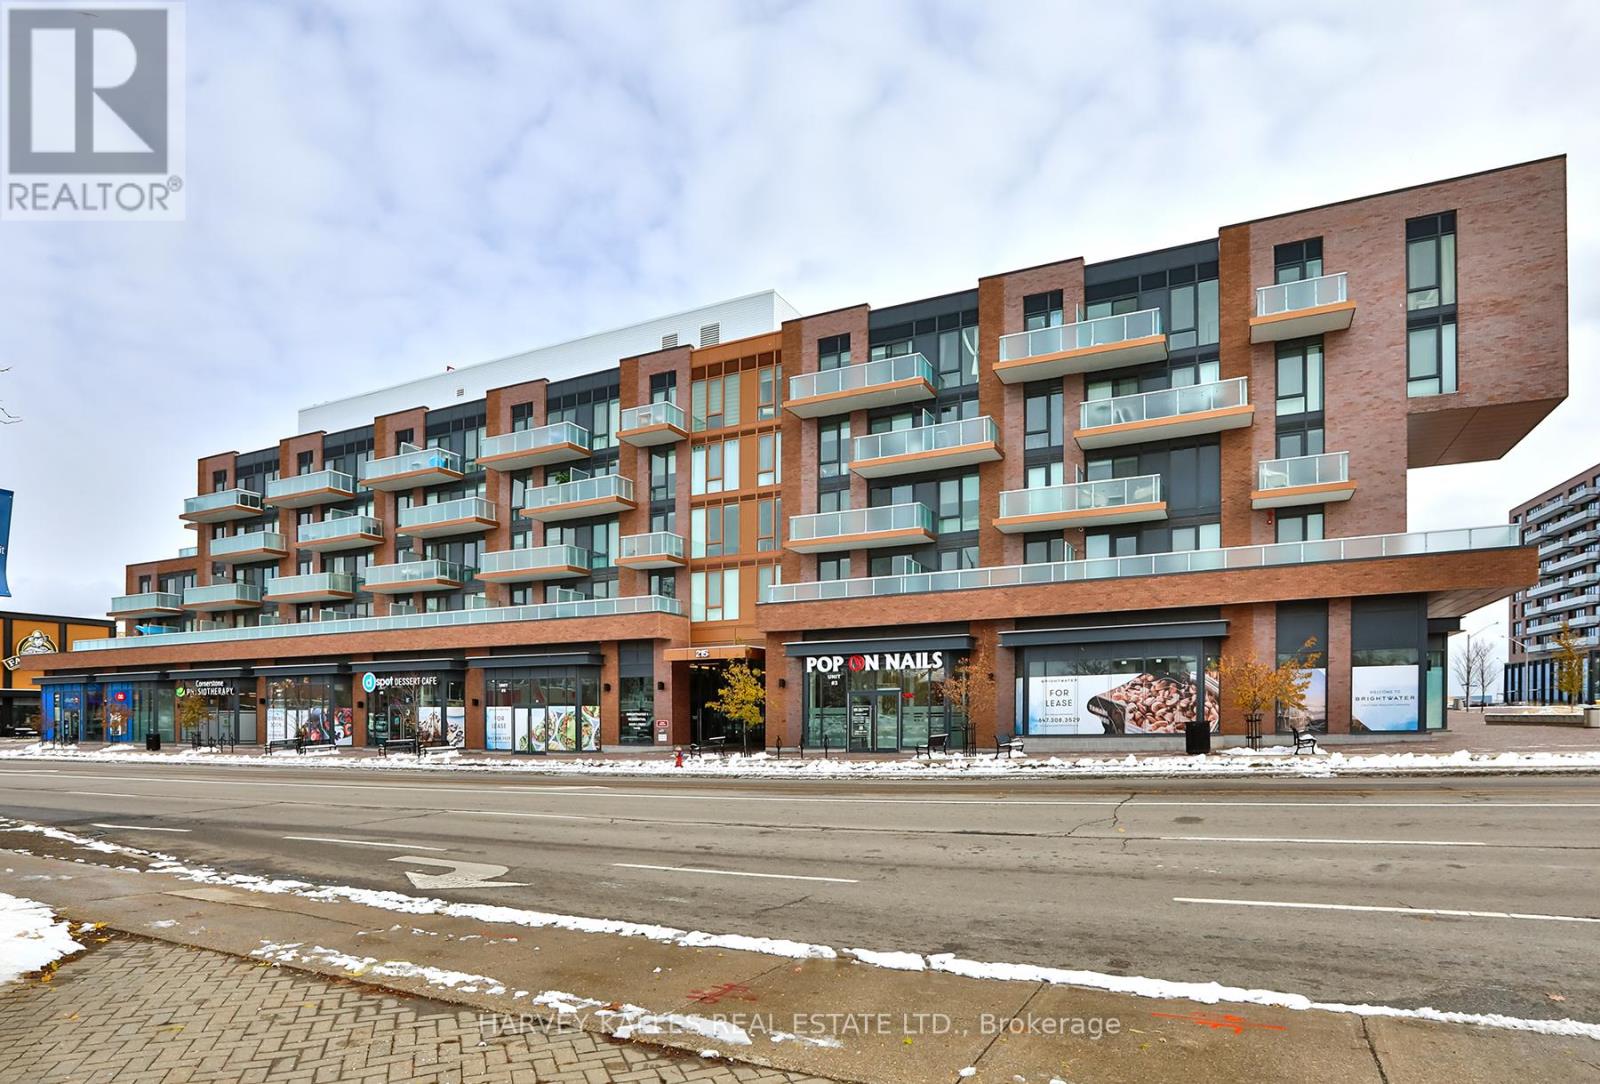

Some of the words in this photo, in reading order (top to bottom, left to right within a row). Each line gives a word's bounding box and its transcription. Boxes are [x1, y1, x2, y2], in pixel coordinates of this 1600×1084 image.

[806, 656, 844, 673] POP
[848, 654, 879, 672] ON
[884, 651, 943, 671] NAILS
[395, 676, 420, 686] DESSERT
[421, 676, 438, 686] CAFE
[1049, 689, 1069, 697] FOR
[1045, 699, 1073, 707] LEASE
